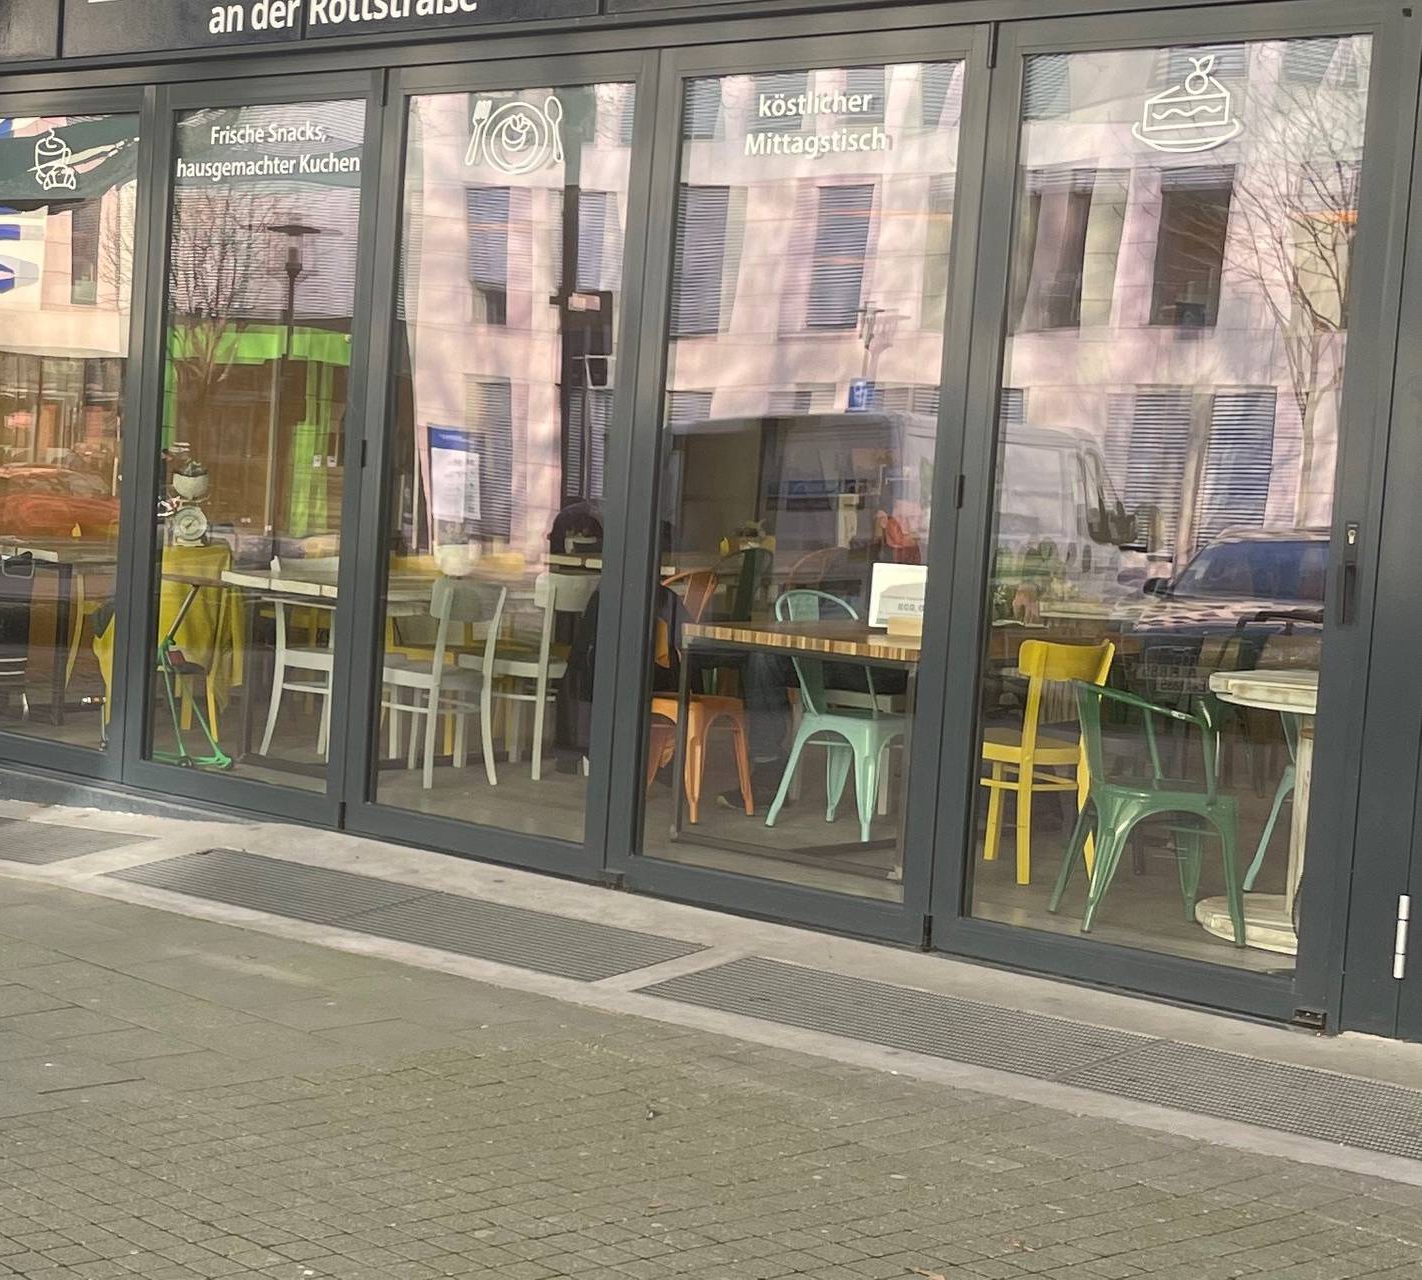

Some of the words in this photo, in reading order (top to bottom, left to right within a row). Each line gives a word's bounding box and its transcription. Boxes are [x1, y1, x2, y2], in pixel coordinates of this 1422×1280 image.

[208, 4, 243, 34] an
[251, 0, 300, 31] der
[758, 89, 873, 118] köstlicher
[210, 124, 264, 146] Frische
[267, 121, 327, 143] Snacks,
[744, 126, 887, 159] Mittagstisch
[176, 155, 296, 182] hausgemachter
[299, 152, 360, 174] Kuchen
